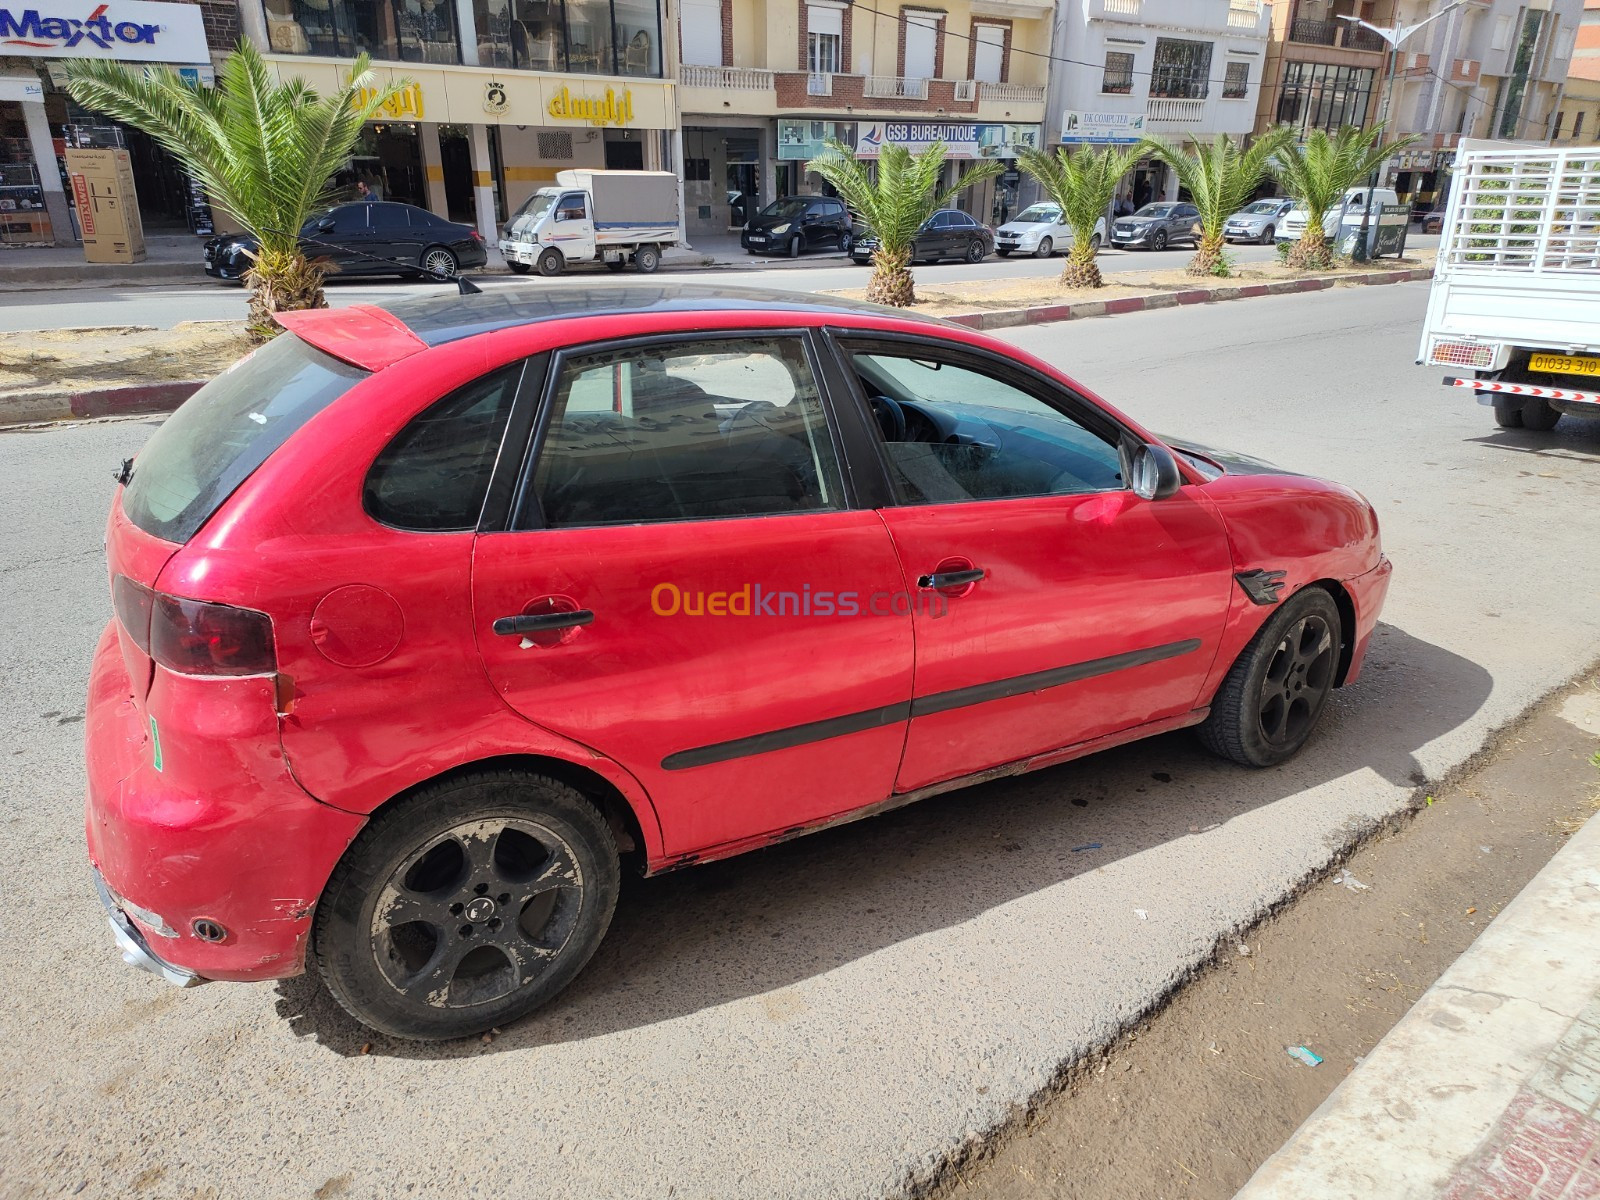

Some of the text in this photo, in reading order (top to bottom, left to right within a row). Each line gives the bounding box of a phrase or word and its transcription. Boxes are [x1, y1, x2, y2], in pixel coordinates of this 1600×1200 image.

[0, 5, 160, 49] Maxtor
[1094, 114, 1128, 124] COMPUTER
[887, 124, 977, 141] GSB BUREAUTIQUE
[1535, 357, 1597, 373] 01033 310
